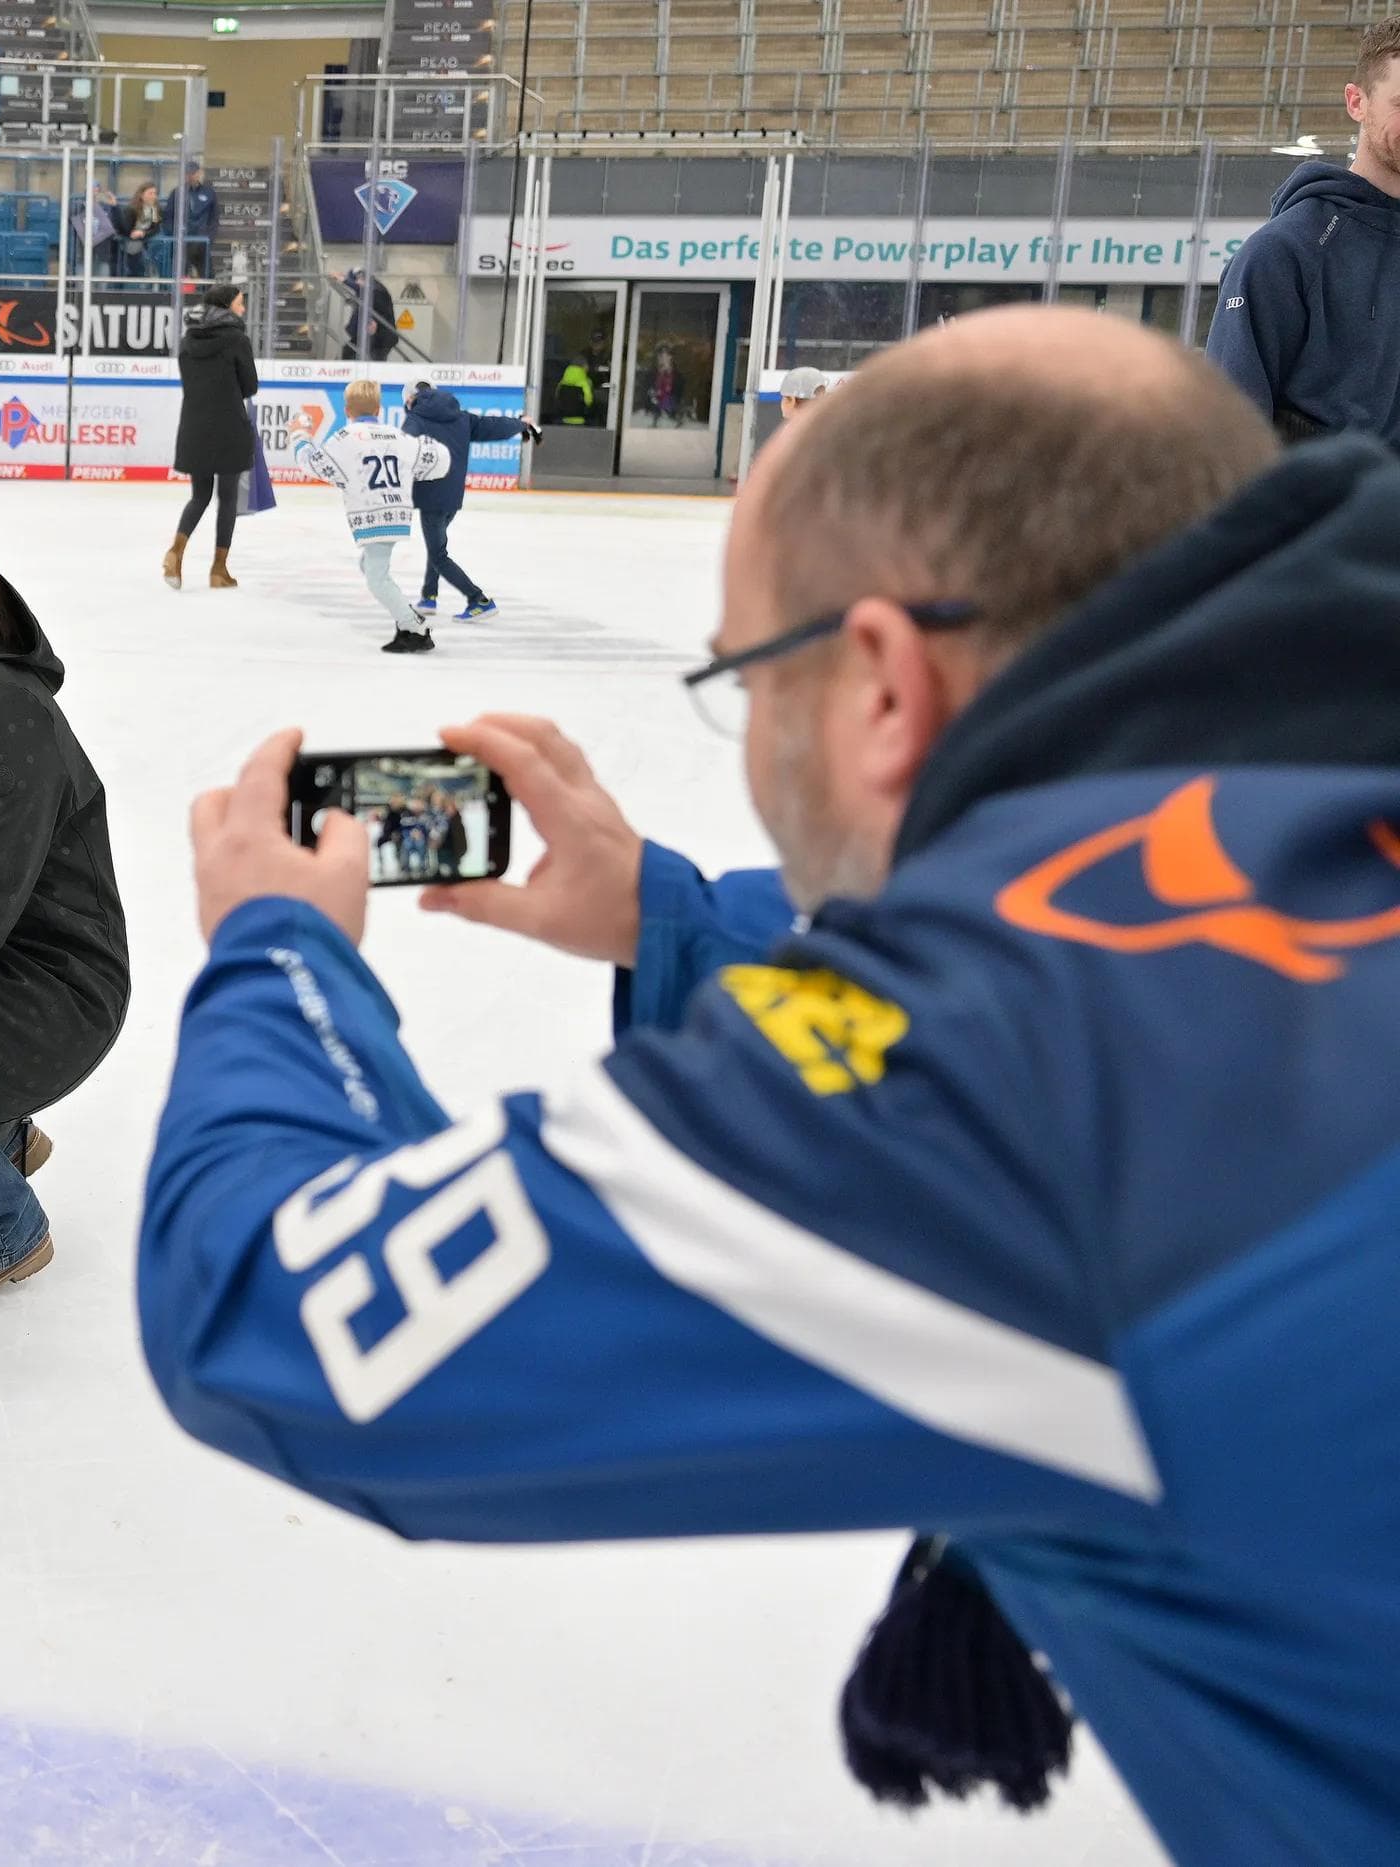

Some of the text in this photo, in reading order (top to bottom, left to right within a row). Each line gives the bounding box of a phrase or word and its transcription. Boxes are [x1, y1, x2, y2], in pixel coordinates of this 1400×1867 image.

[611, 236, 669, 259] Das
[678, 233, 822, 266] perfete
[833, 236, 1018, 269] Powerplay
[1030, 236, 1077, 263] für
[1091, 237, 1163, 264] Ihre
[477, 254, 574, 273] Sysec
[21, 361, 53, 372] Audi
[130, 363, 162, 374] Audi
[468, 370, 501, 380] Audi
[3, 402, 137, 445] PAULESER
[363, 455, 401, 490] 20
